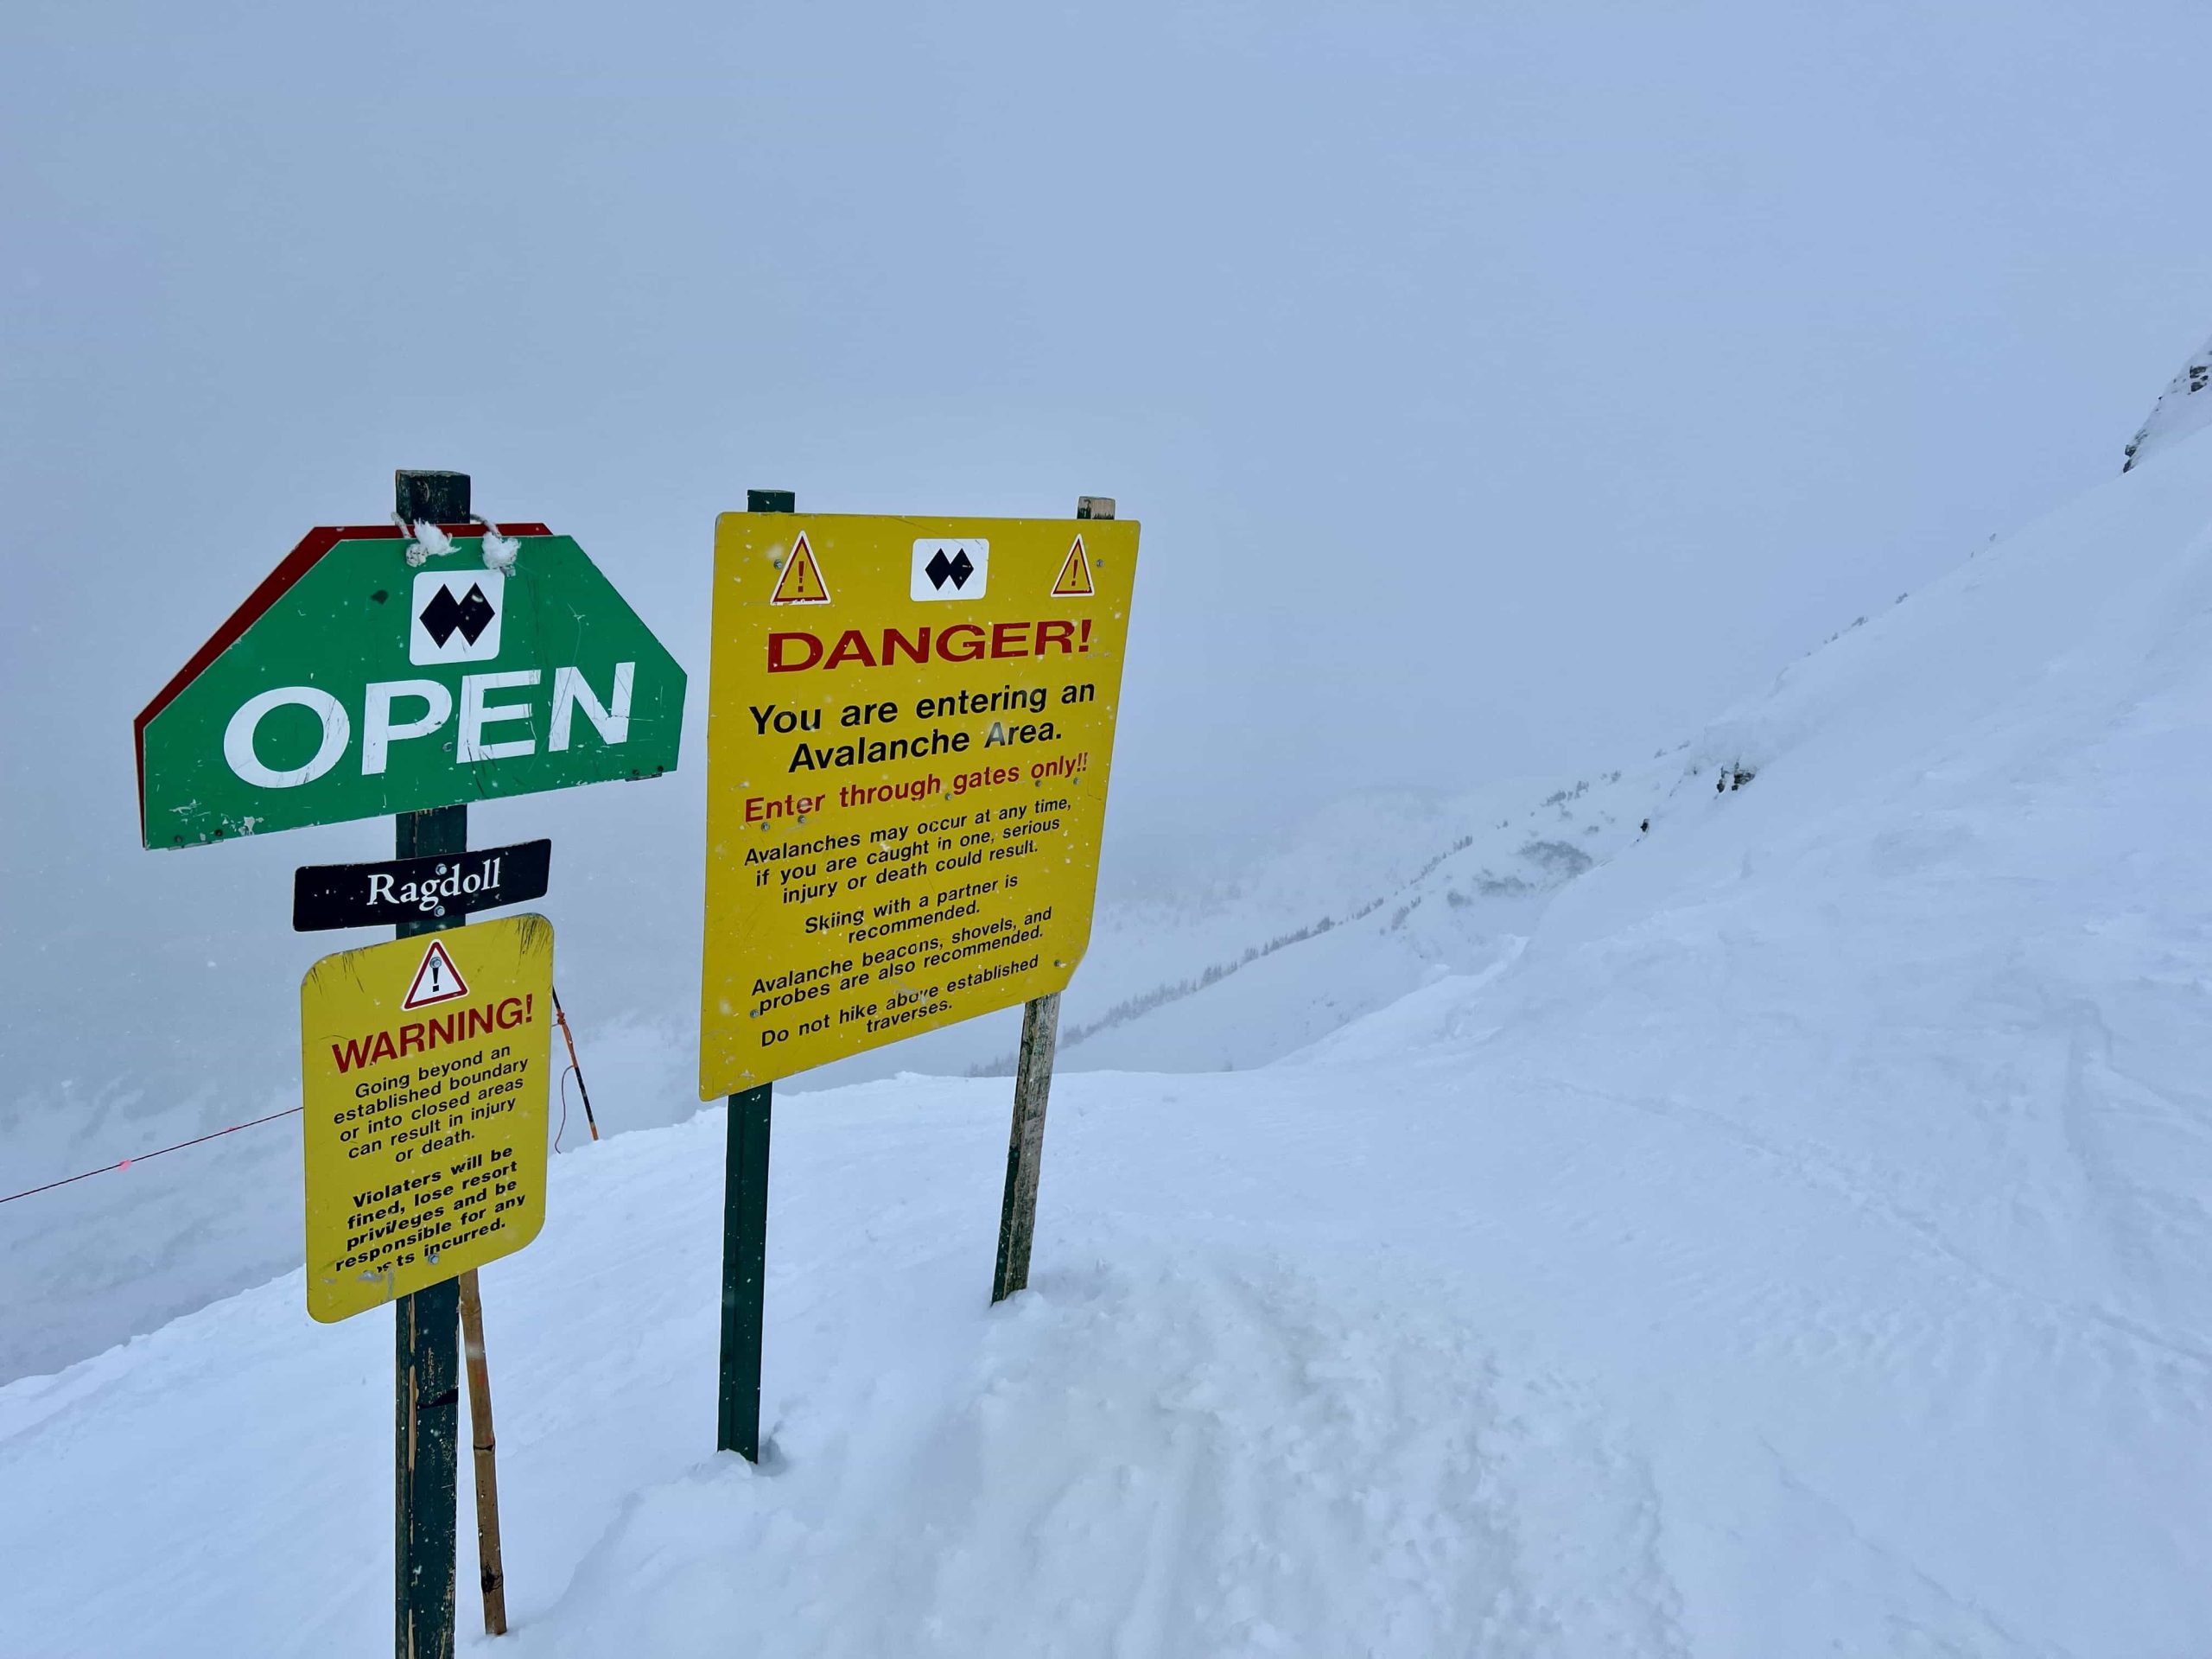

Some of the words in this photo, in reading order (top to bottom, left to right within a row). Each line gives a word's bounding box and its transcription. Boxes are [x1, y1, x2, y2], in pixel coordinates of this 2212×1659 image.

[767, 619, 1092, 673] DANGER!
[223, 662, 636, 789] OPEN
[749, 704, 822, 735] You
[841, 701, 898, 728] are
[916, 684, 1046, 718] entering
[1062, 683, 1095, 704] an
[788, 728, 969, 773] Avalanche
[984, 721, 1063, 748] Area.
[745, 791, 825, 823] Enter
[840, 774, 941, 807] through
[953, 766, 1020, 796] gates
[1030, 752, 1089, 782] only!!
[744, 834, 861, 866] Avalanches
[870, 826, 908, 842] may
[917, 815, 967, 835] occur
[975, 809, 990, 824] at
[998, 804, 1027, 820] any
[1034, 798, 1071, 813] time,
[756, 868, 769, 887] if
[780, 864, 816, 885] you
[825, 856, 857, 873] are
[867, 840, 929, 865] caught
[938, 837, 951, 851] in
[960, 831, 995, 848] one,
[1002, 818, 1060, 839] serious
[366, 857, 500, 912] Ragdoll
[783, 881, 837, 904] injury
[847, 875, 868, 890] or
[875, 864, 927, 885] death
[935, 849, 982, 872] could
[989, 840, 1038, 861] result.
[804, 909, 864, 934] Skiing
[873, 897, 911, 918] with
[918, 896, 929, 907] a
[937, 879, 998, 906] partner
[1005, 874, 1018, 888] is
[751, 959, 853, 996] Avalanche
[862, 938, 944, 967] beacons,
[951, 918, 1017, 944] shovels,
[1024, 906, 1052, 926] and
[849, 900, 980, 944] recommended.
[760, 982, 830, 1016] probes
[840, 973, 869, 990] are
[878, 960, 916, 980] also
[924, 925, 1043, 968] recommended.
[761, 1029, 789, 1047] Do
[798, 1014, 830, 1035] not
[839, 1003, 877, 1024] hike
[886, 986, 938, 1010] above
[947, 954, 1039, 992] established
[331, 994, 533, 1074] WARNING!
[867, 999, 952, 1033] traverses.
[334, 1080, 442, 1124] established
[449, 1058, 529, 1090] boundary
[354, 1073, 410, 1098] Going
[418, 1051, 482, 1081] beyond
[490, 1046, 511, 1060] an
[340, 1126, 359, 1142] or
[368, 1115, 403, 1135] into
[410, 1090, 470, 1121] closed
[478, 1077, 524, 1100] areas
[348, 1140, 382, 1159] can
[391, 1119, 441, 1146] result
[448, 1114, 463, 1128] in
[471, 1098, 516, 1121] injury
[353, 1171, 442, 1208] Violaters
[450, 1154, 482, 1175] will
[491, 1147, 512, 1162] be
[395, 1148, 414, 1163] or
[422, 1128, 475, 1154] death.
[346, 1200, 405, 1230] fined,
[414, 1185, 454, 1207] lose
[462, 1160, 518, 1190] resort
[346, 1206, 444, 1251] privileges
[454, 1188, 487, 1211] and
[495, 1180, 517, 1198] be
[335, 1222, 452, 1272] responsible
[461, 1206, 486, 1225] for
[494, 1194, 526, 1214] any
[424, 1218, 505, 1257] incurred.
